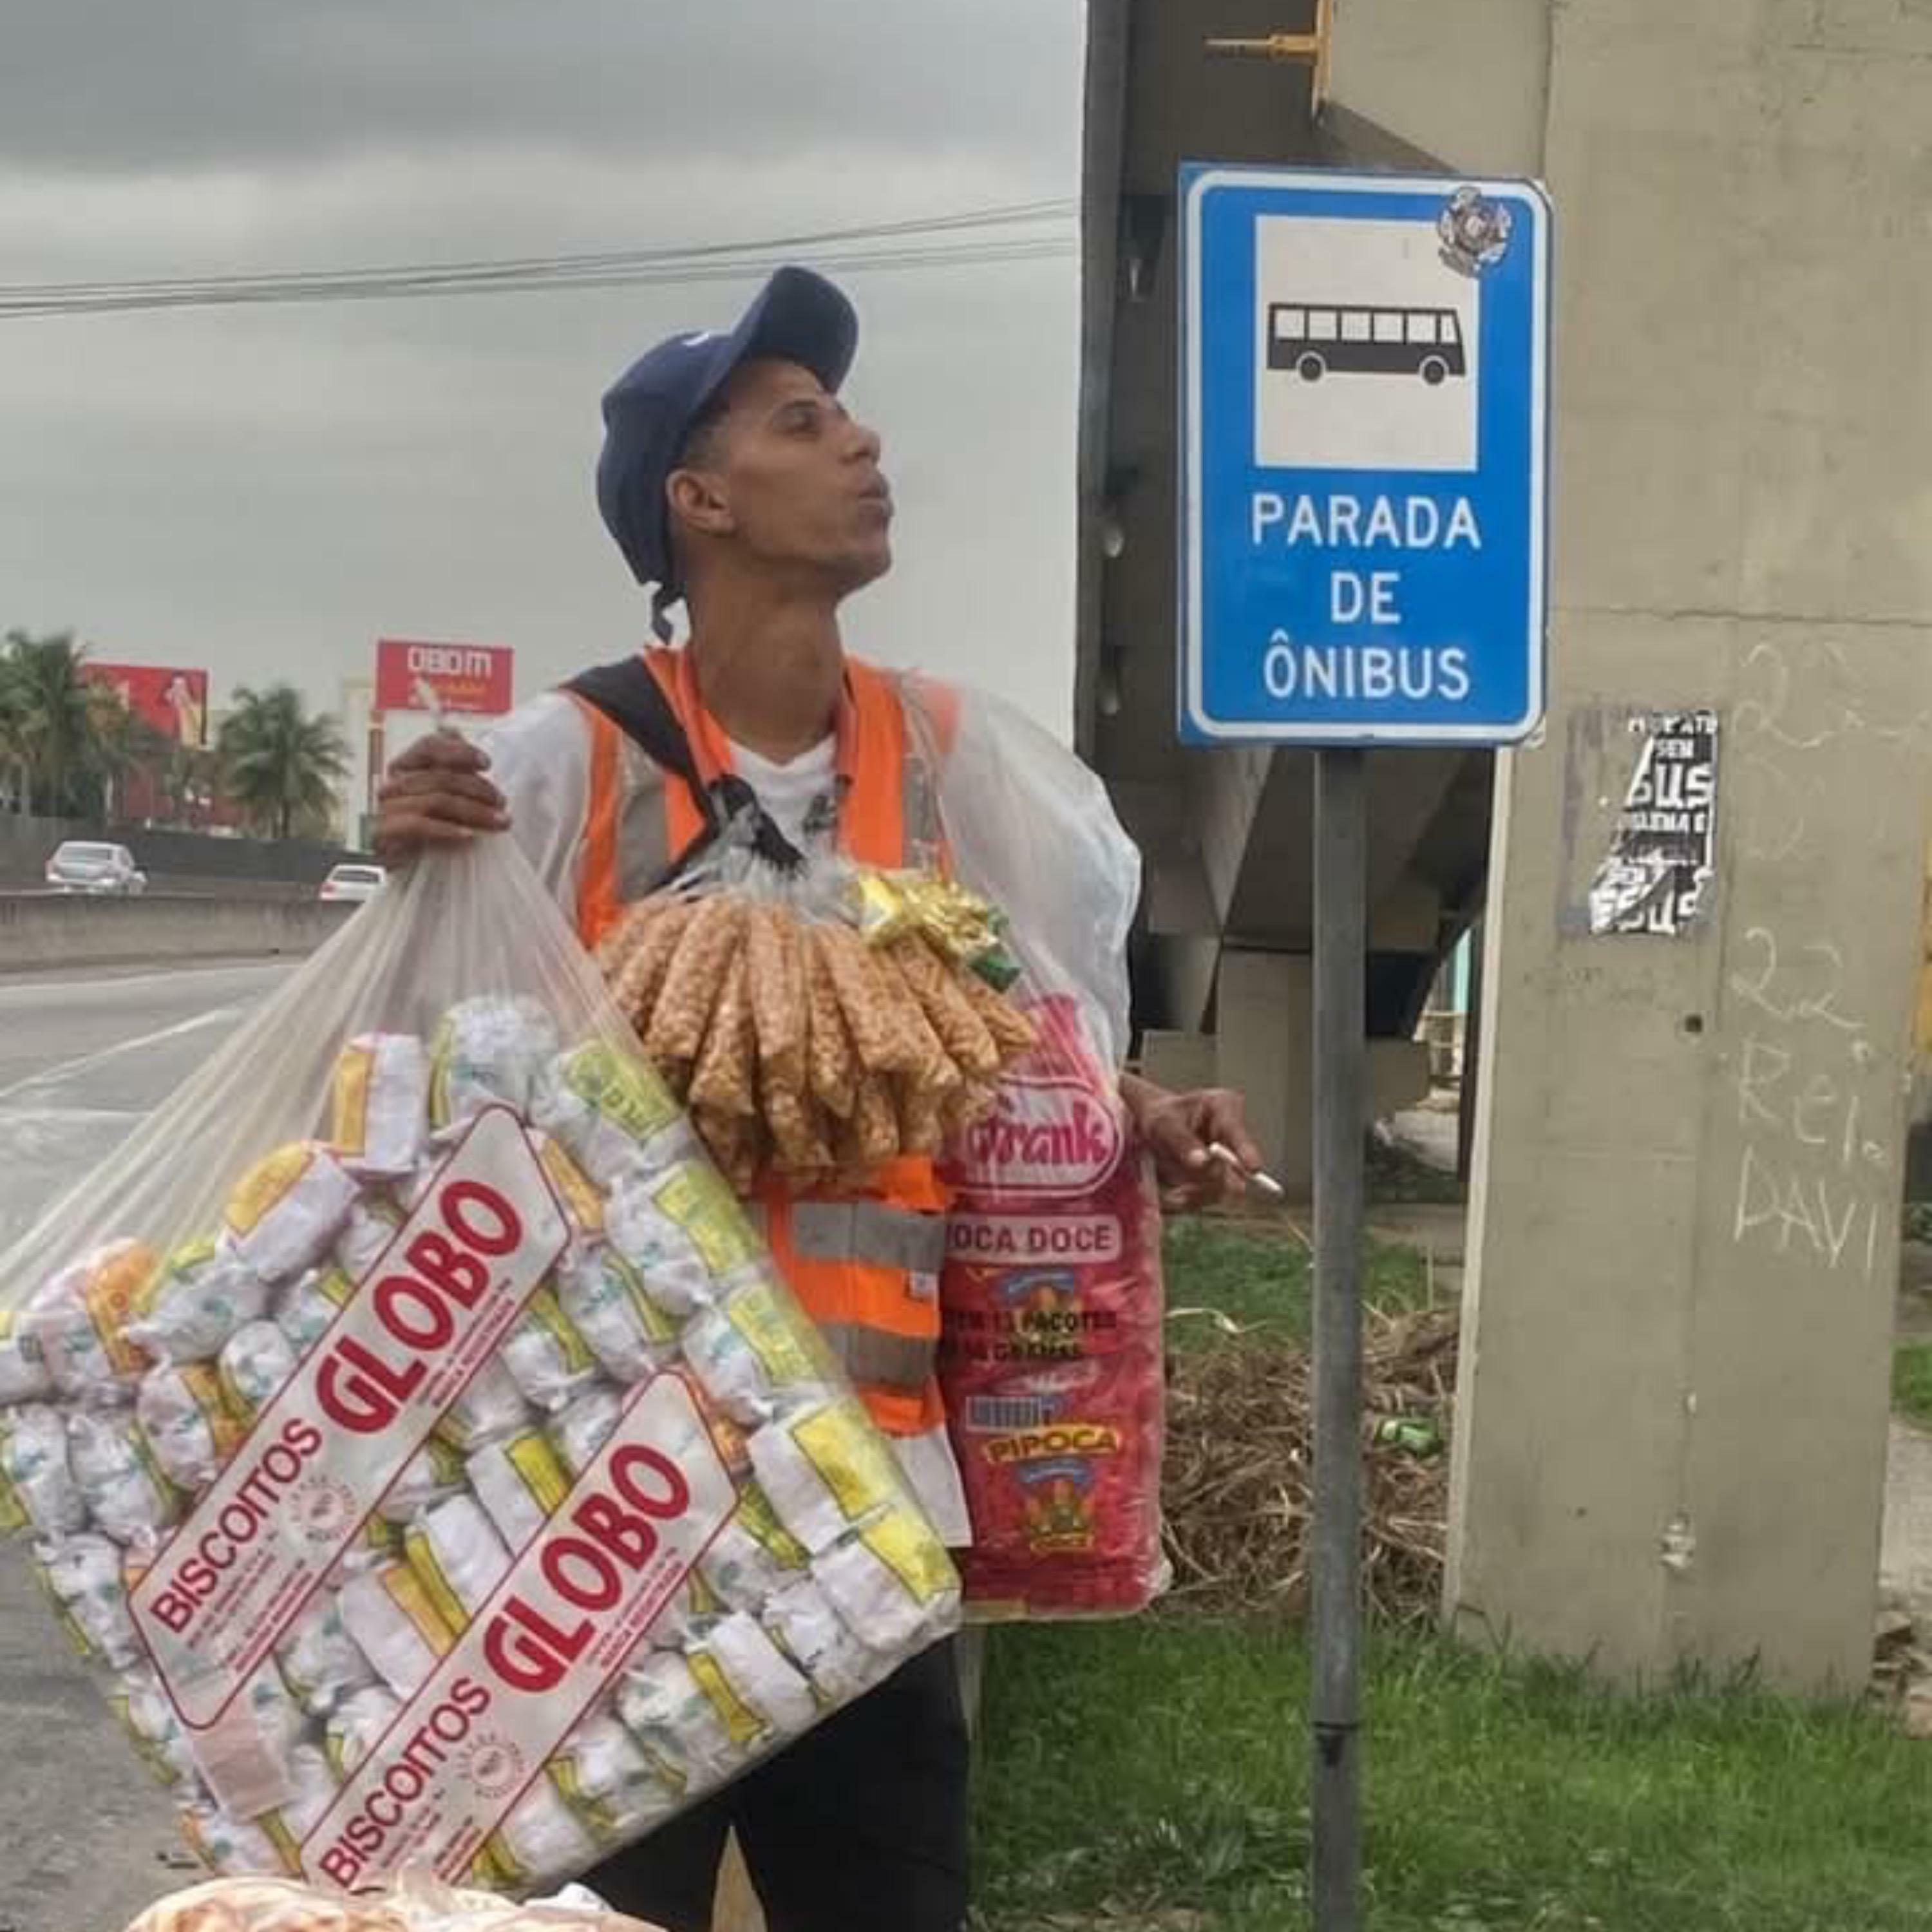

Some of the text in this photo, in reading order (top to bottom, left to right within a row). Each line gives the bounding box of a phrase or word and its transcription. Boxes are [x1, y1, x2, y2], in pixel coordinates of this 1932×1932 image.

[1252, 493, 1481, 549] PARADA
[1331, 571, 1401, 623] DE
[1264, 629, 1470, 700] ÔNIBUS
[946, 1225, 1112, 1253] OCA DOCE
[149, 1419, 322, 1633] BISCOITOS
[316, 1180, 524, 1434] GLOBO
[988, 1428, 1118, 1463] PIPOCA
[318, 1676, 491, 1890] BISCOITOS
[483, 1444, 690, 1692] GLOBO
